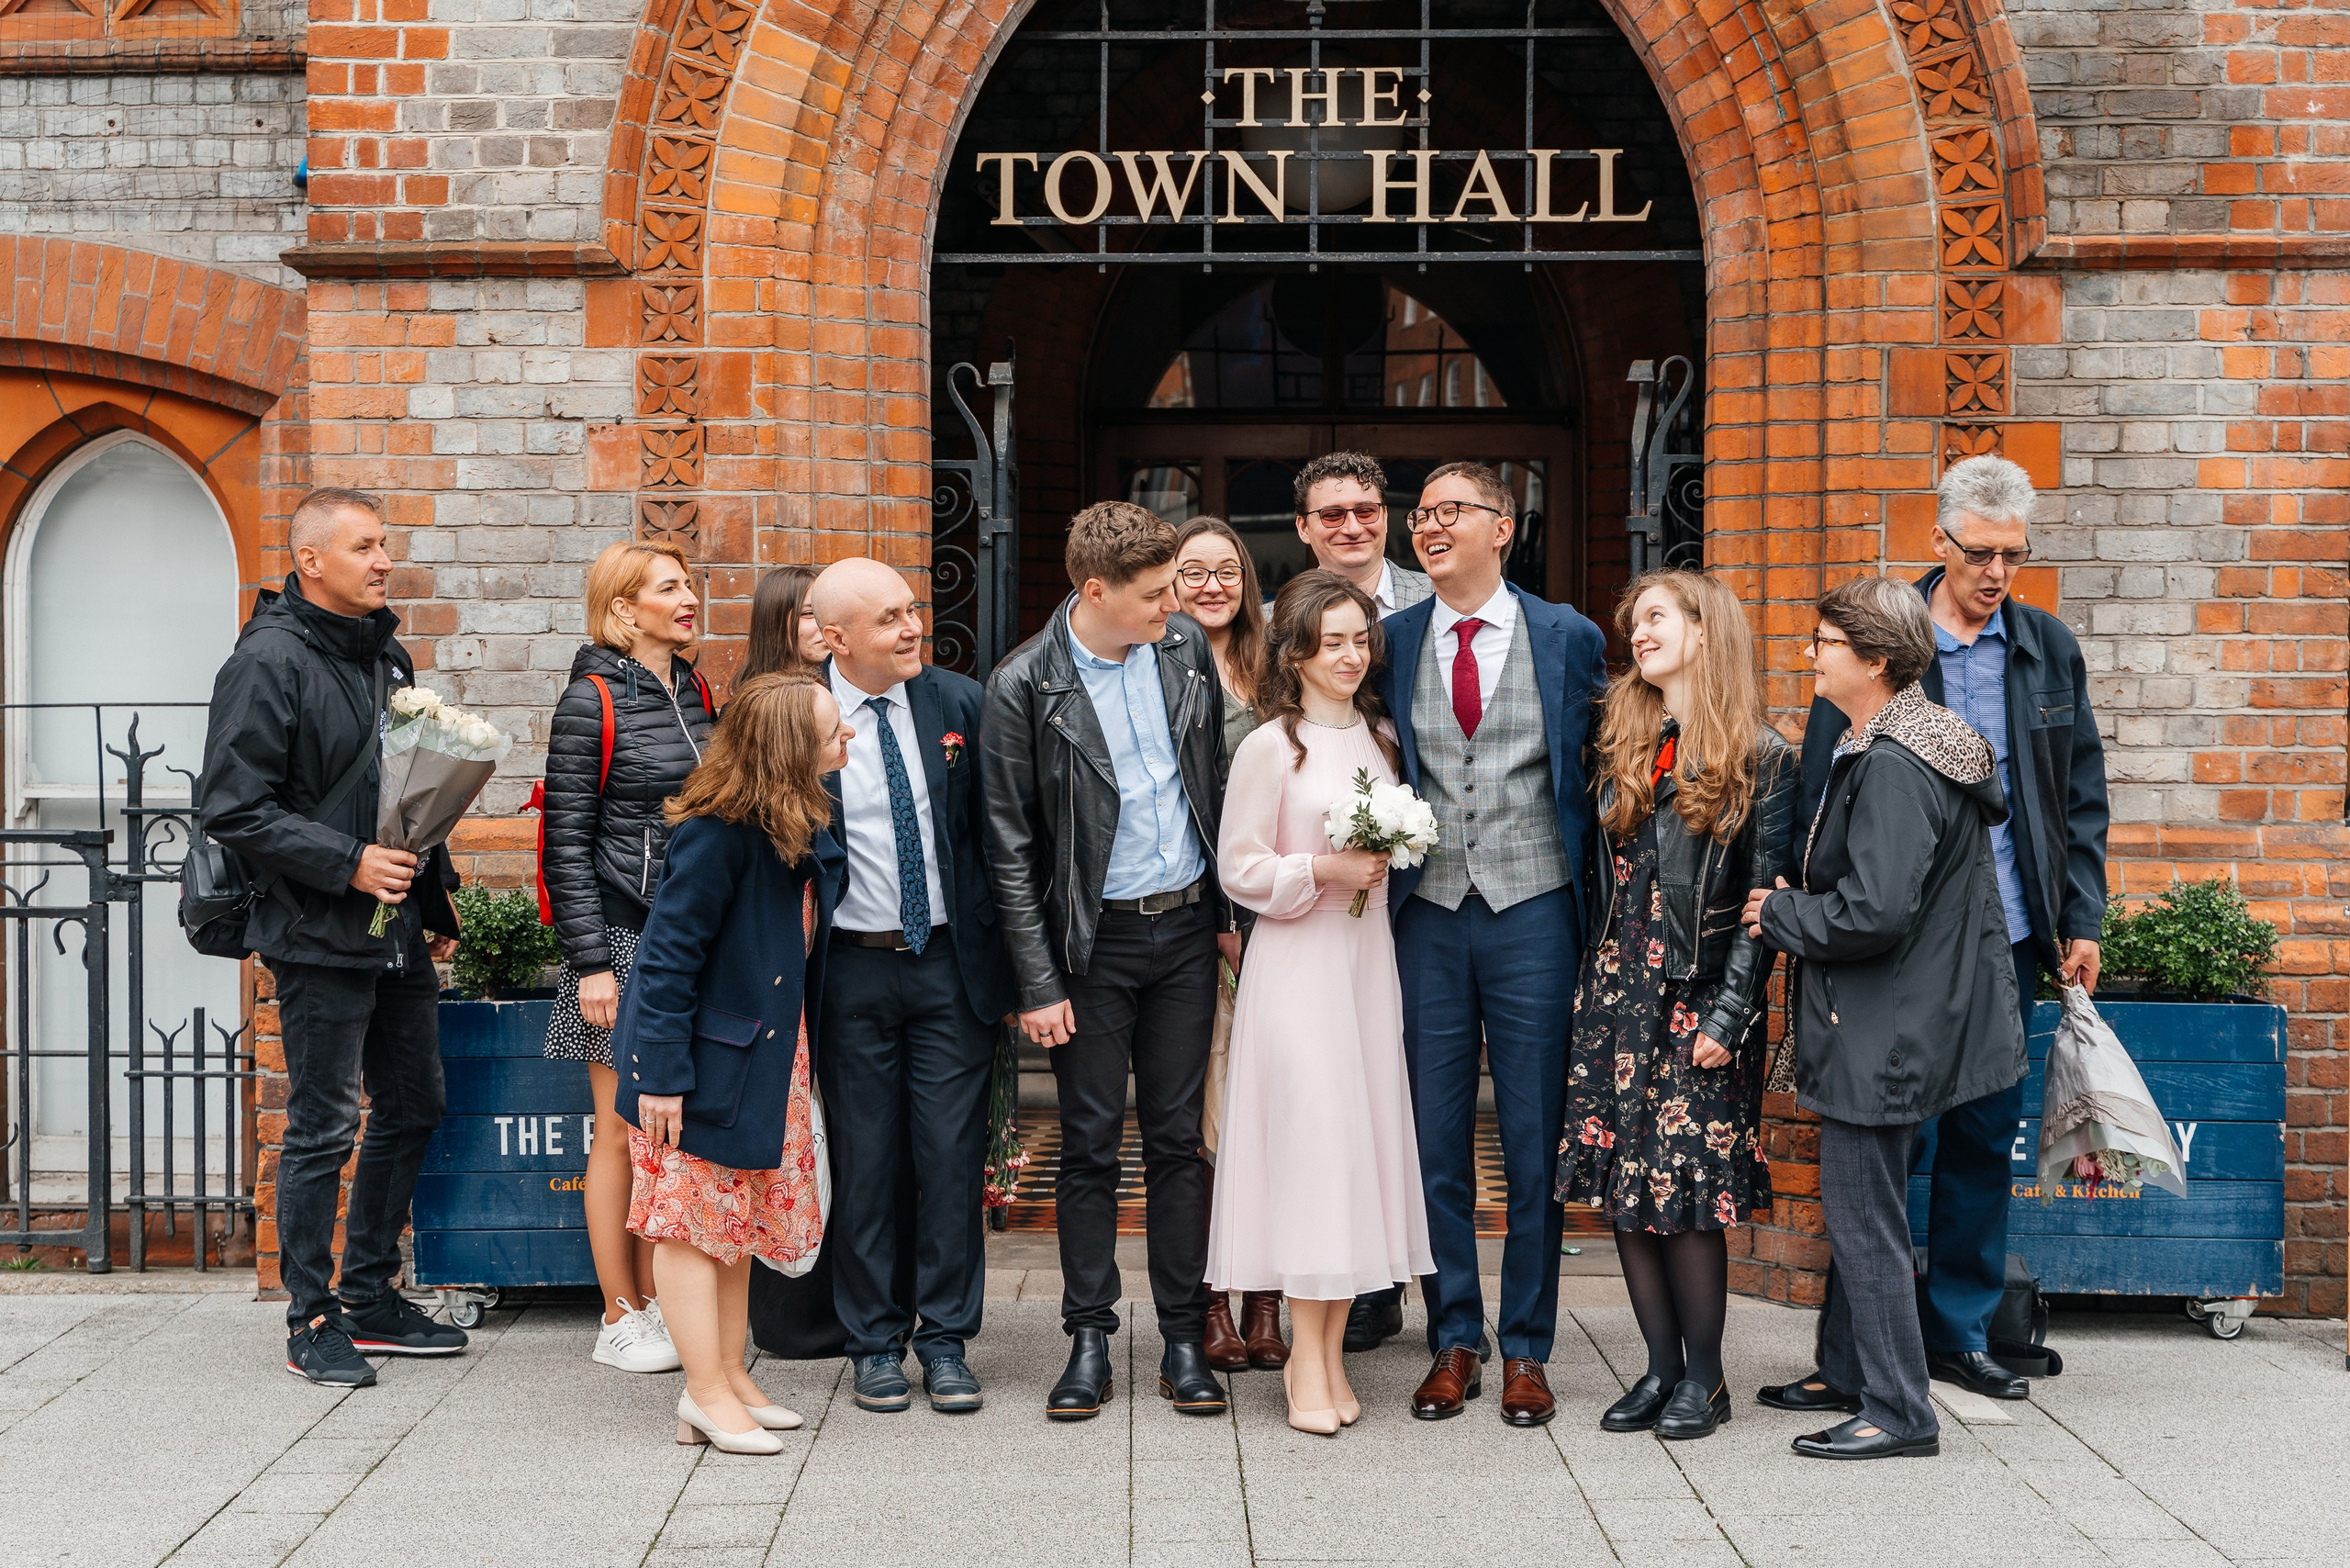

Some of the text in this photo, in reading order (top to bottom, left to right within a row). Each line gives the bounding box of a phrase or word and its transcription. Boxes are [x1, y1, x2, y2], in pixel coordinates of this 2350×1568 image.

[1224, 67, 1408, 127] THE
[976, 149, 1652, 225] TOWN HALL
[495, 1116, 564, 1155] THE
[2010, 1183, 2042, 1198] Caf
[2054, 1184, 2067, 1198] &
